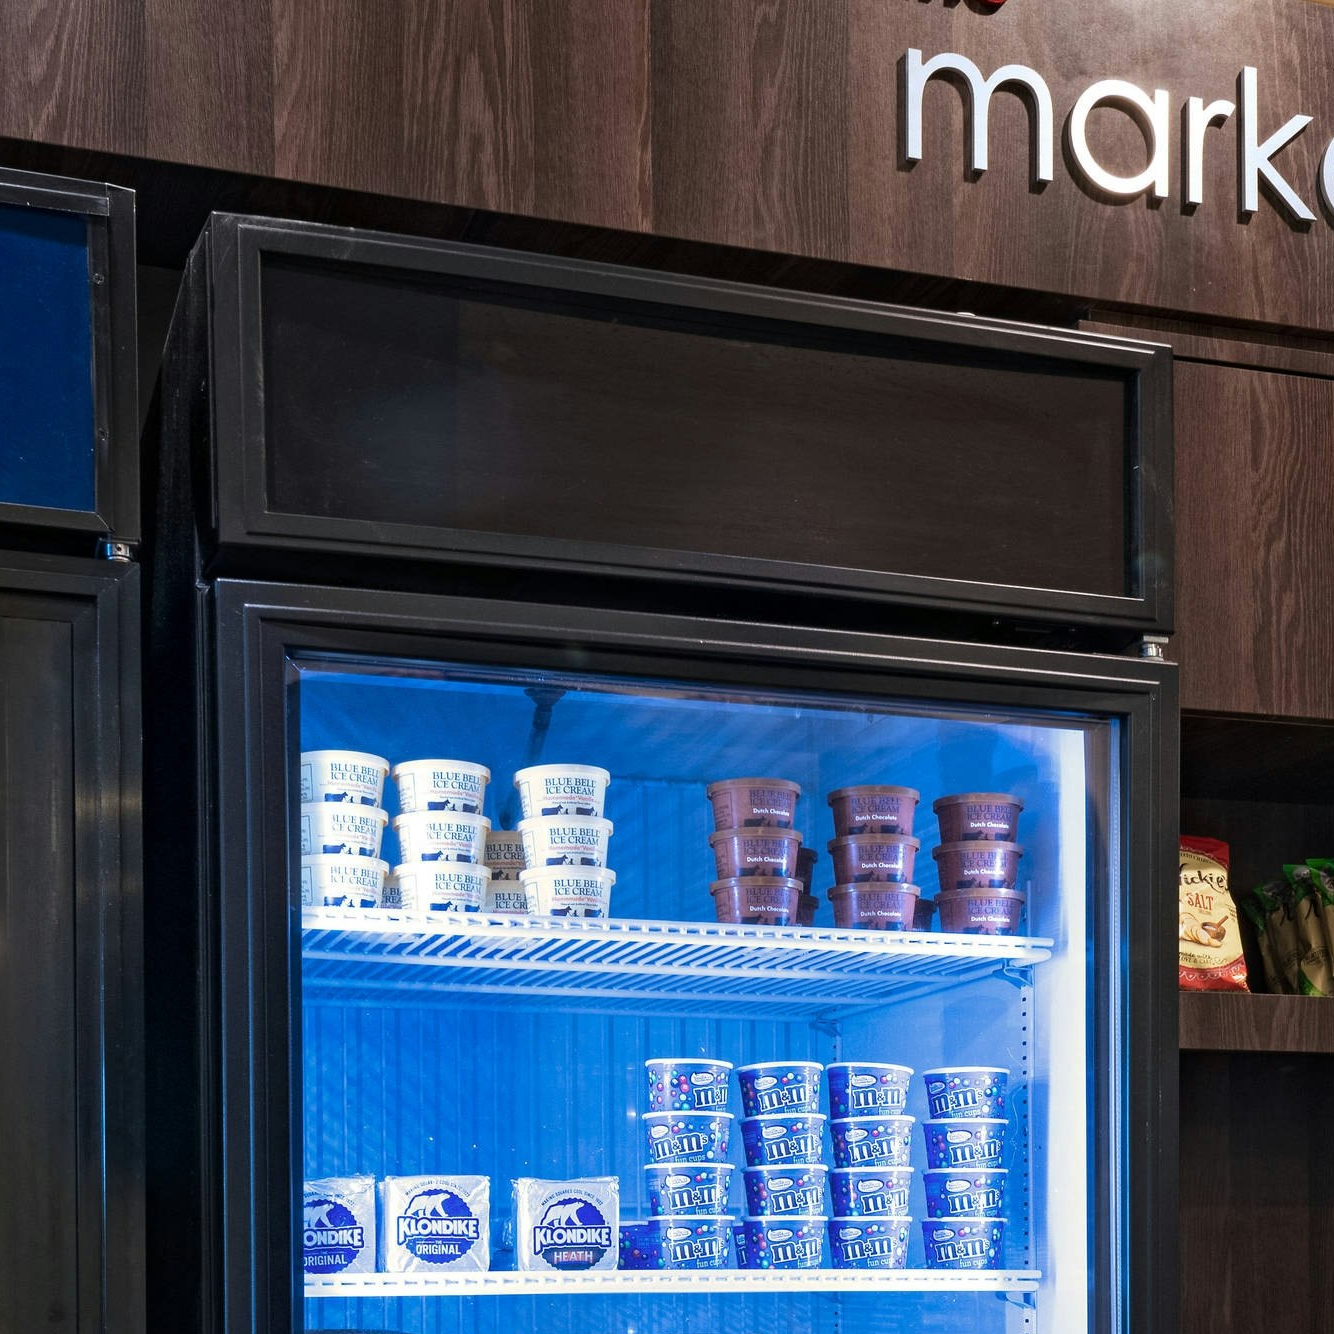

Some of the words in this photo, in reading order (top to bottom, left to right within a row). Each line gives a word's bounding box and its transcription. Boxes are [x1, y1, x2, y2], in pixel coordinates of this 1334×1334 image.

[432, 771, 459, 782] BLUE
[461, 773, 481, 784] BELL
[545, 777, 572, 787] BLUE
[573, 778, 595, 789] BELL
[432, 779, 448, 789] ICE
[449, 780, 481, 793] CREAM
[545, 785, 561, 795] ICE
[562, 785, 595, 797] CREAM
[549, 827, 576, 837] BLUE
[566, 835, 599, 847] CREAM
[1186, 893, 1214, 911] SALT
[932, 1088, 983, 1115] m&m's
[653, 1132, 708, 1160] m&m's
[398, 1217, 479, 1244] KLONDIKE
[304, 1227, 364, 1248] ONDIKE
[534, 1227, 611, 1254] KLONDIKE
[416, 1244, 462, 1255] ORIGINAL
[935, 1237, 990, 1263] m&m's
[554, 1250, 594, 1263] HEATH
[959, 1258, 972, 1268] fun
[972, 1258, 988, 1268] cups
